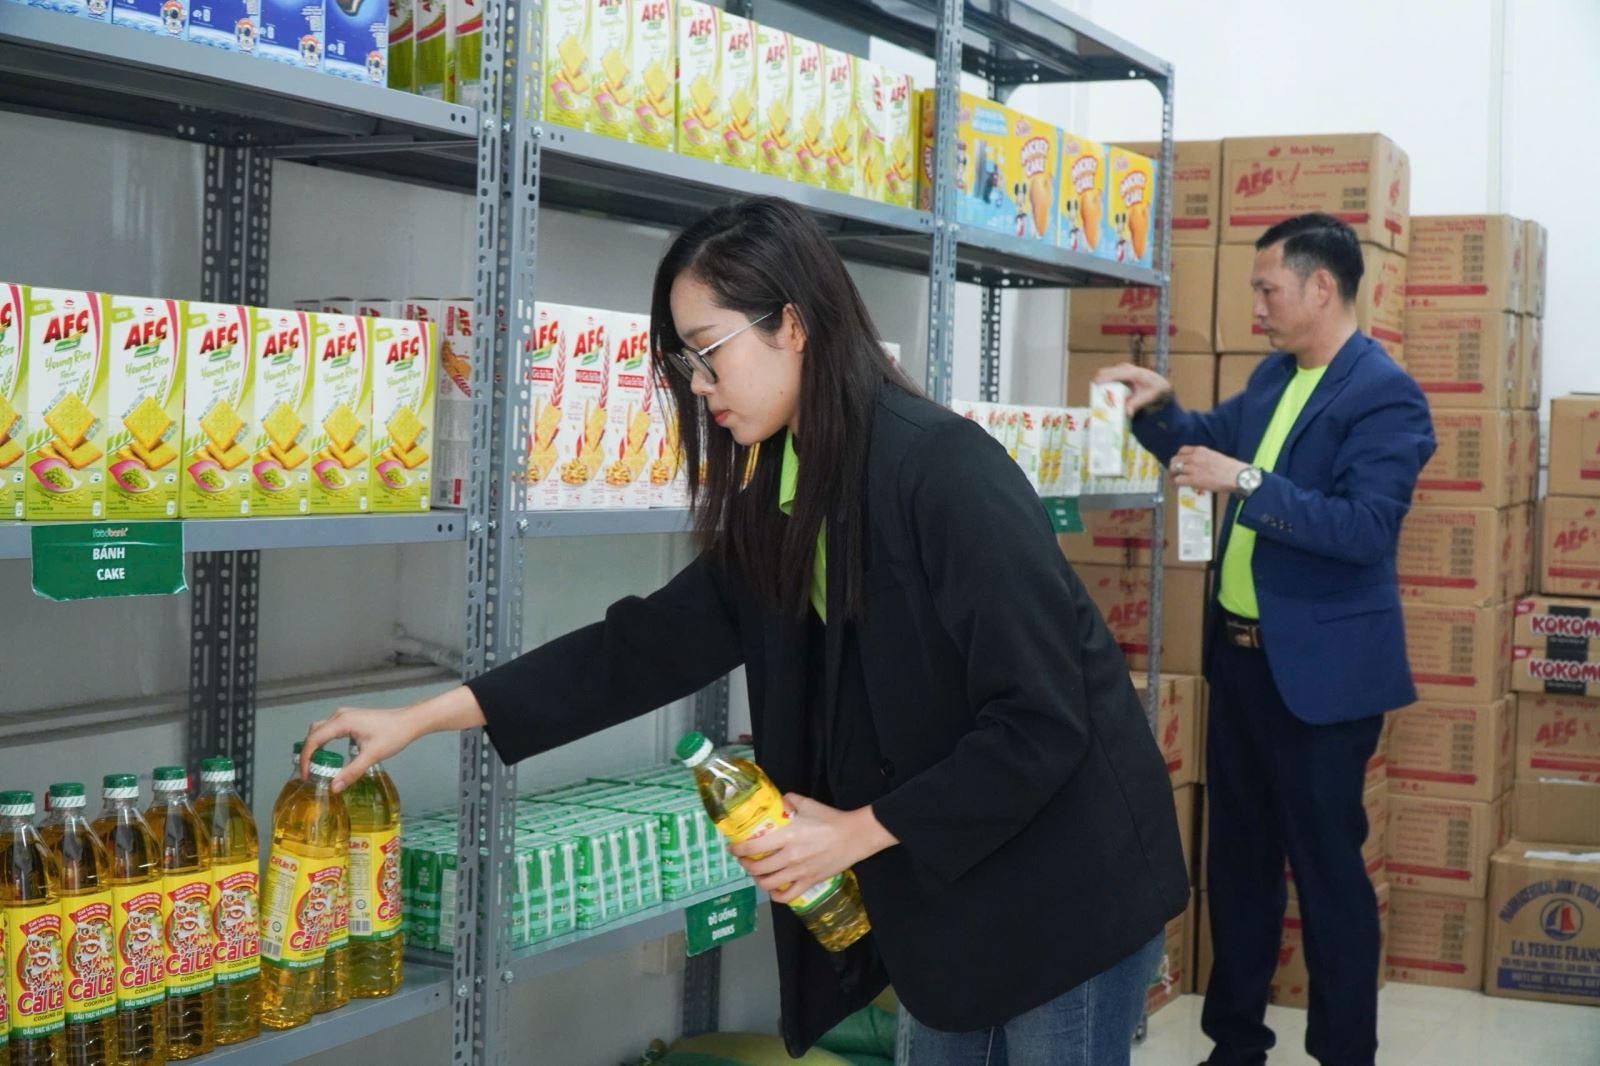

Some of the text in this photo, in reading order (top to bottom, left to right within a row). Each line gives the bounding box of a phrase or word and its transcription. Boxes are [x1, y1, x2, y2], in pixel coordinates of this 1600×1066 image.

[641, 3, 665, 22] AFC
[689, 18, 712, 38] AFC
[1235, 168, 1274, 195] AFC
[43, 309, 89, 345] AFC
[124, 317, 168, 350] AFC
[199, 322, 239, 355] AFC
[573, 325, 604, 358] AFC
[263, 327, 299, 359] AFC
[322, 331, 357, 361] AFC
[385, 336, 420, 365] AFC
[615, 331, 648, 363] AFC
[92, 544, 126, 561] BÁNH
[96, 567, 126, 581] CAKE
